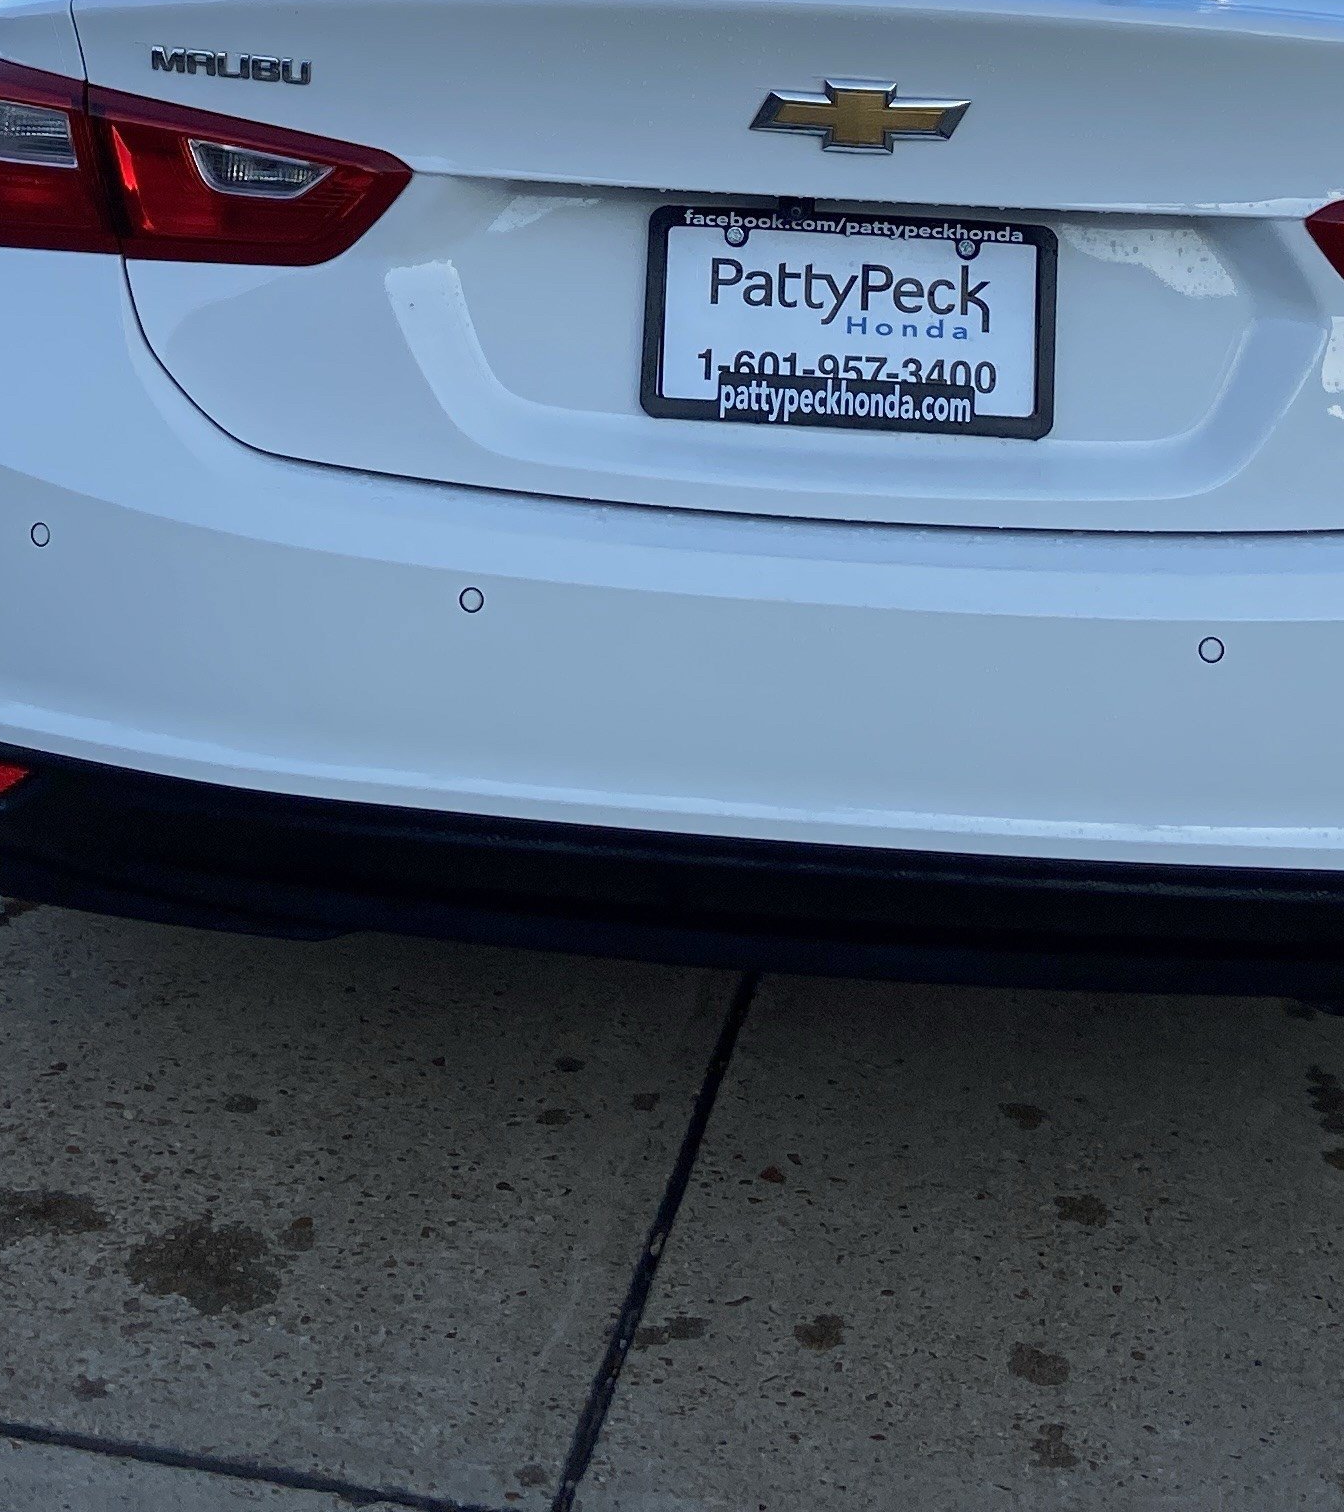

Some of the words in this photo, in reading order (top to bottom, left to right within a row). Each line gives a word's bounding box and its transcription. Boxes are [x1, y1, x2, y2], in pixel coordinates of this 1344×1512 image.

[151, 45, 312, 86] MALIBU
[684, 209, 1024, 243] facebook.com/pattypeckhonda
[710, 256, 991, 333] PattyPeck
[846, 315, 969, 341] Honda
[697, 348, 997, 394] 1-601-957-3400
[719, 379, 972, 423] pattypeckhonda.com
